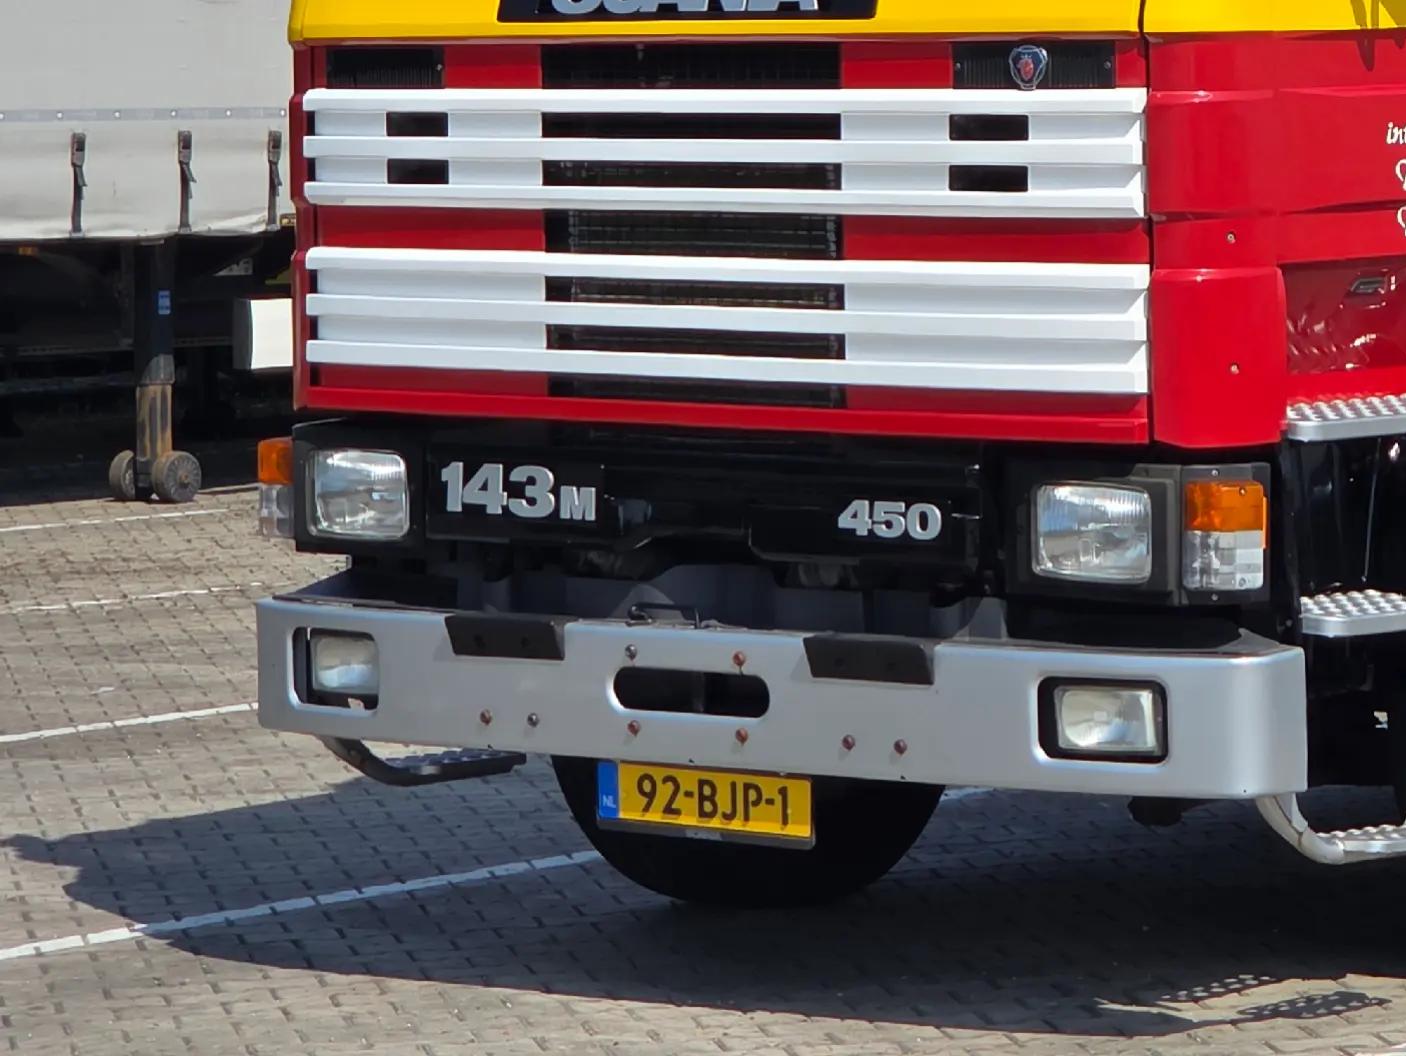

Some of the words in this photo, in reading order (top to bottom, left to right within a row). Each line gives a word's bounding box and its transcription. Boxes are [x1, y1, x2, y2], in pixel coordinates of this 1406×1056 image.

[837, 499, 942, 541] 450
[602, 795, 617, 809] NL
[636, 773, 789, 830] 92-BJP-1
